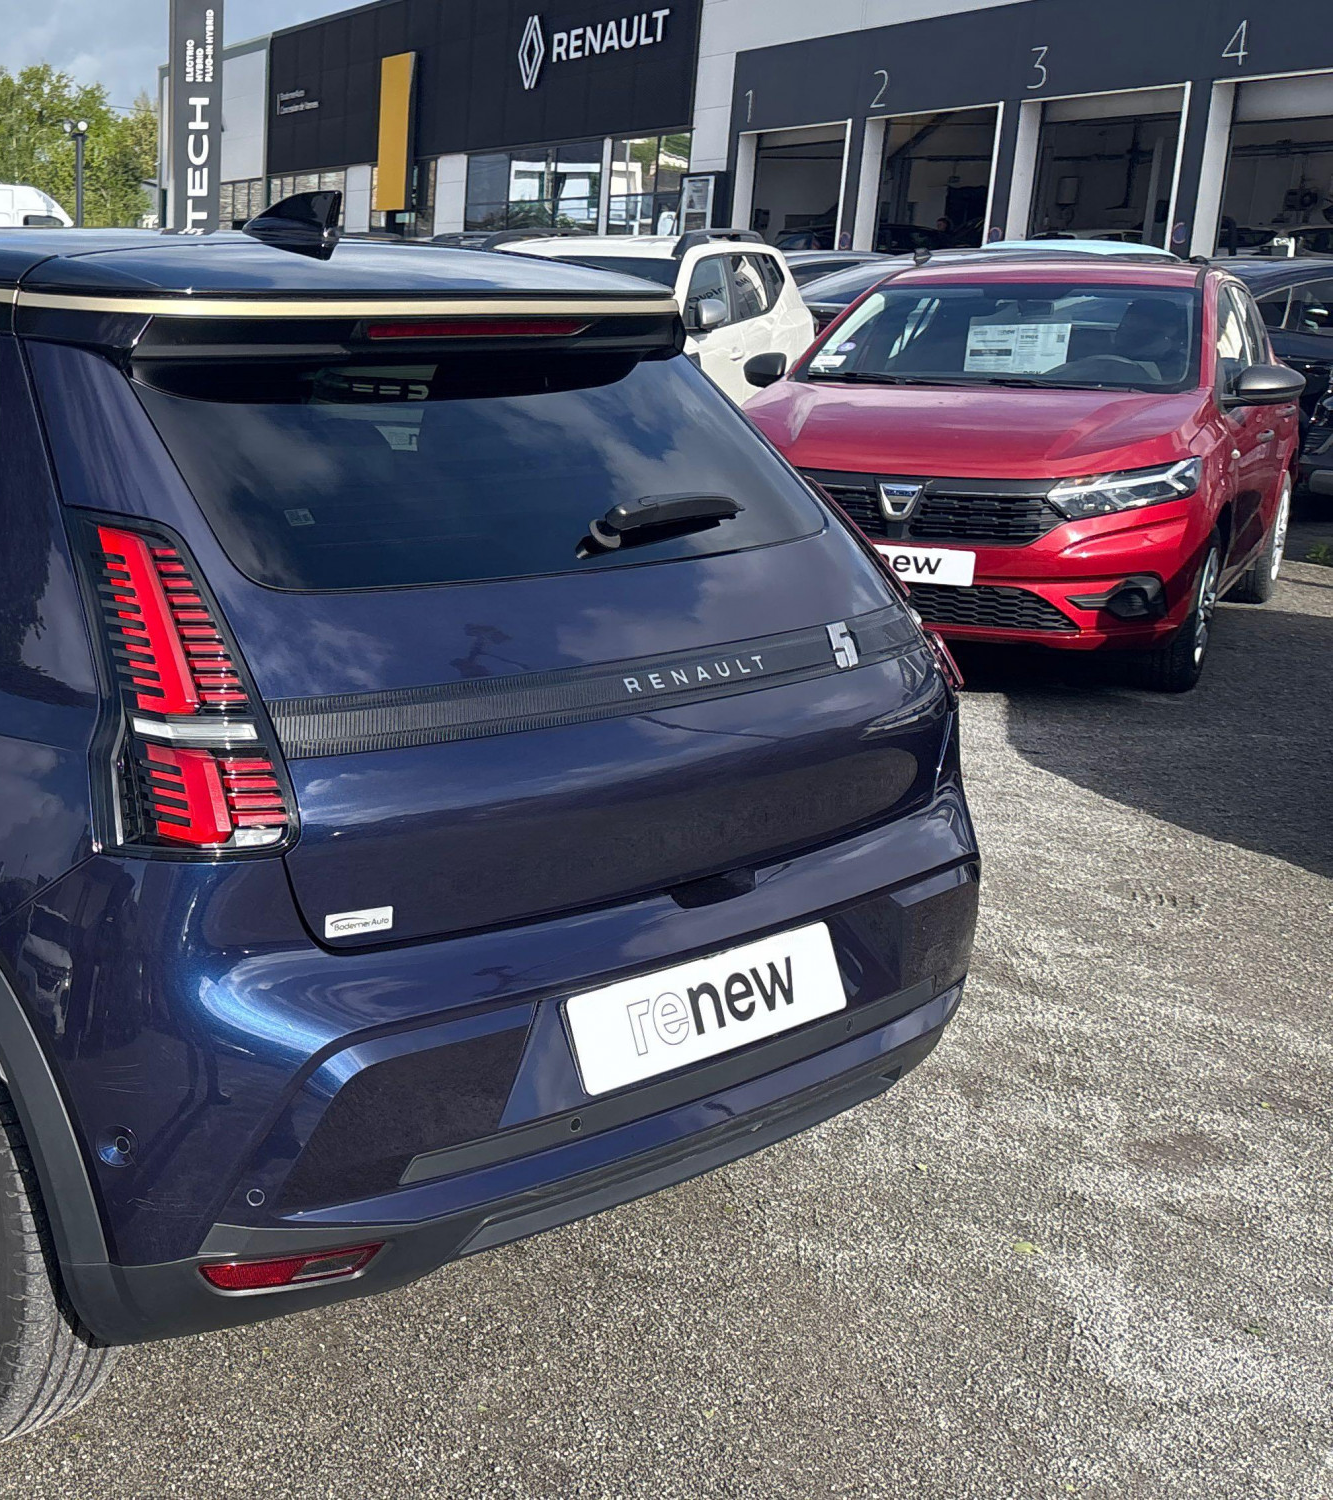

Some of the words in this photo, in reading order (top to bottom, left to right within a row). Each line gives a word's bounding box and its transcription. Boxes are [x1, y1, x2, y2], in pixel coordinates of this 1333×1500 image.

[205, 9, 215, 43] HYBRID
[552, 8, 671, 63] RENAULT
[1222, 20, 1249, 66] 4
[185, 38, 195, 82] ELECTRIC
[195, 47, 204, 82] HYBRID
[205, 45, 214, 82] PLUG-IN
[1027, 46, 1048, 90] 3
[744, 89, 756, 124] 1
[869, 69, 889, 109] 2
[186, 97, 210, 229] TECH
[623, 654, 765, 693] RENAULT
[825, 620, 859, 669] 5
[626, 955, 794, 1056] renew
